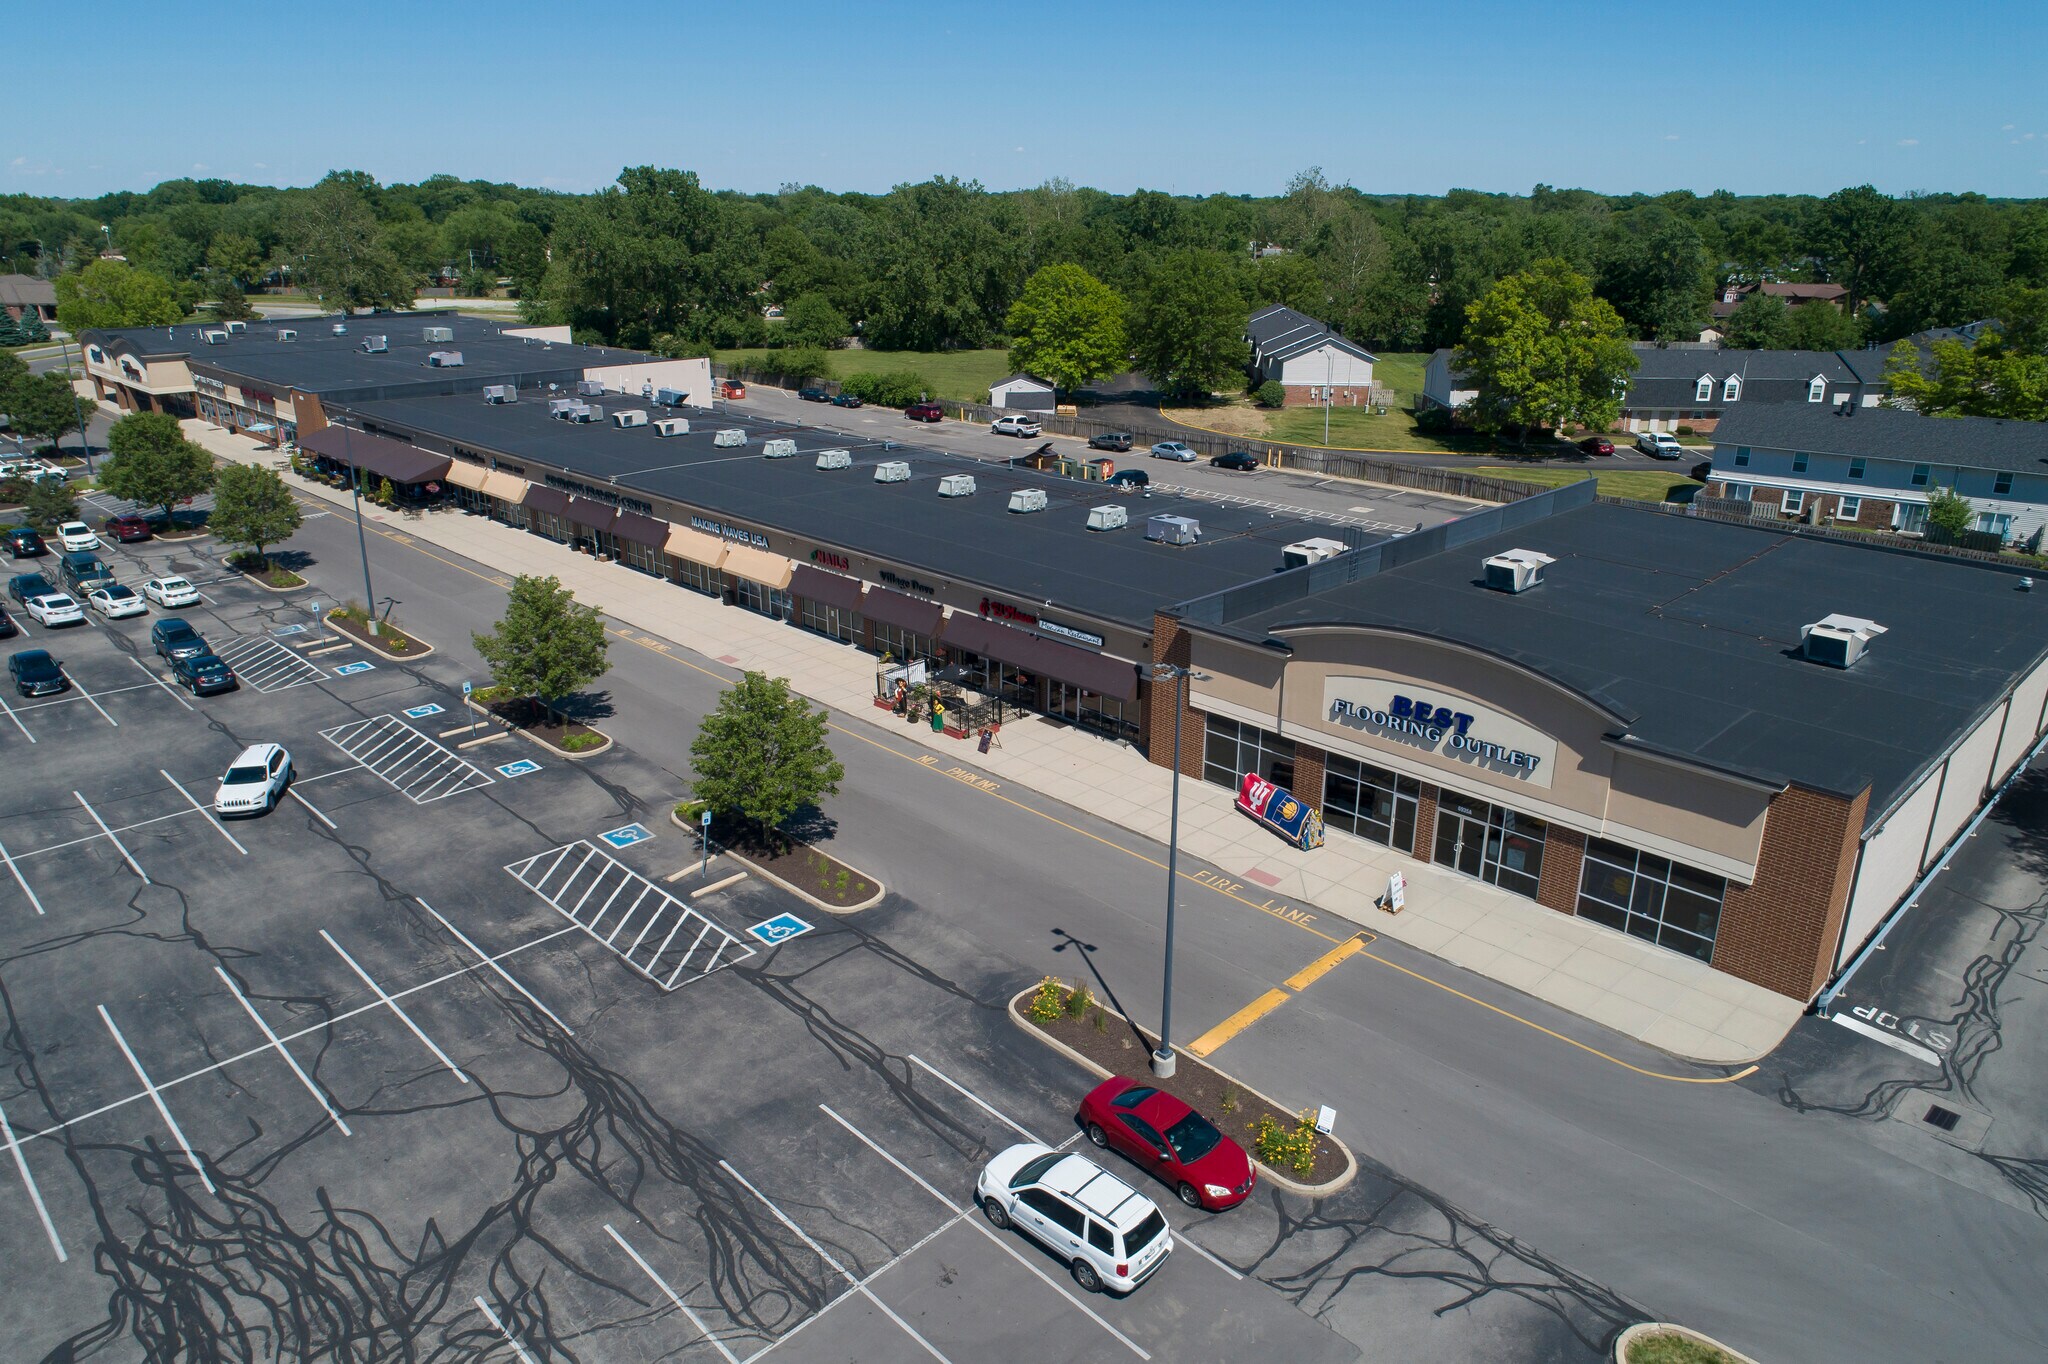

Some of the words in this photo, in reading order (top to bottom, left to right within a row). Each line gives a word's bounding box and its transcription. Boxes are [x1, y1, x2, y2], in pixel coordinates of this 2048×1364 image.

[691, 516, 721, 534] MAKING
[721, 524, 750, 543] WAVES
[751, 533, 770, 548] USA
[816, 549, 849, 571] NAILS
[879, 570, 911, 589] Village
[1040, 621, 1065, 634] Mexican
[1067, 627, 1101, 645] Restaurant
[1391, 694, 1475, 736] BEST
[1333, 698, 1443, 743] FLOORING
[1448, 733, 1541, 771] OUTLET
[915, 754, 939, 765] NO
[945, 766, 1001, 791] PARKING
[1192, 870, 1245, 894] FIRE
[1260, 899, 1318, 926] LANE
[1851, 1004, 1952, 1051] STOP
